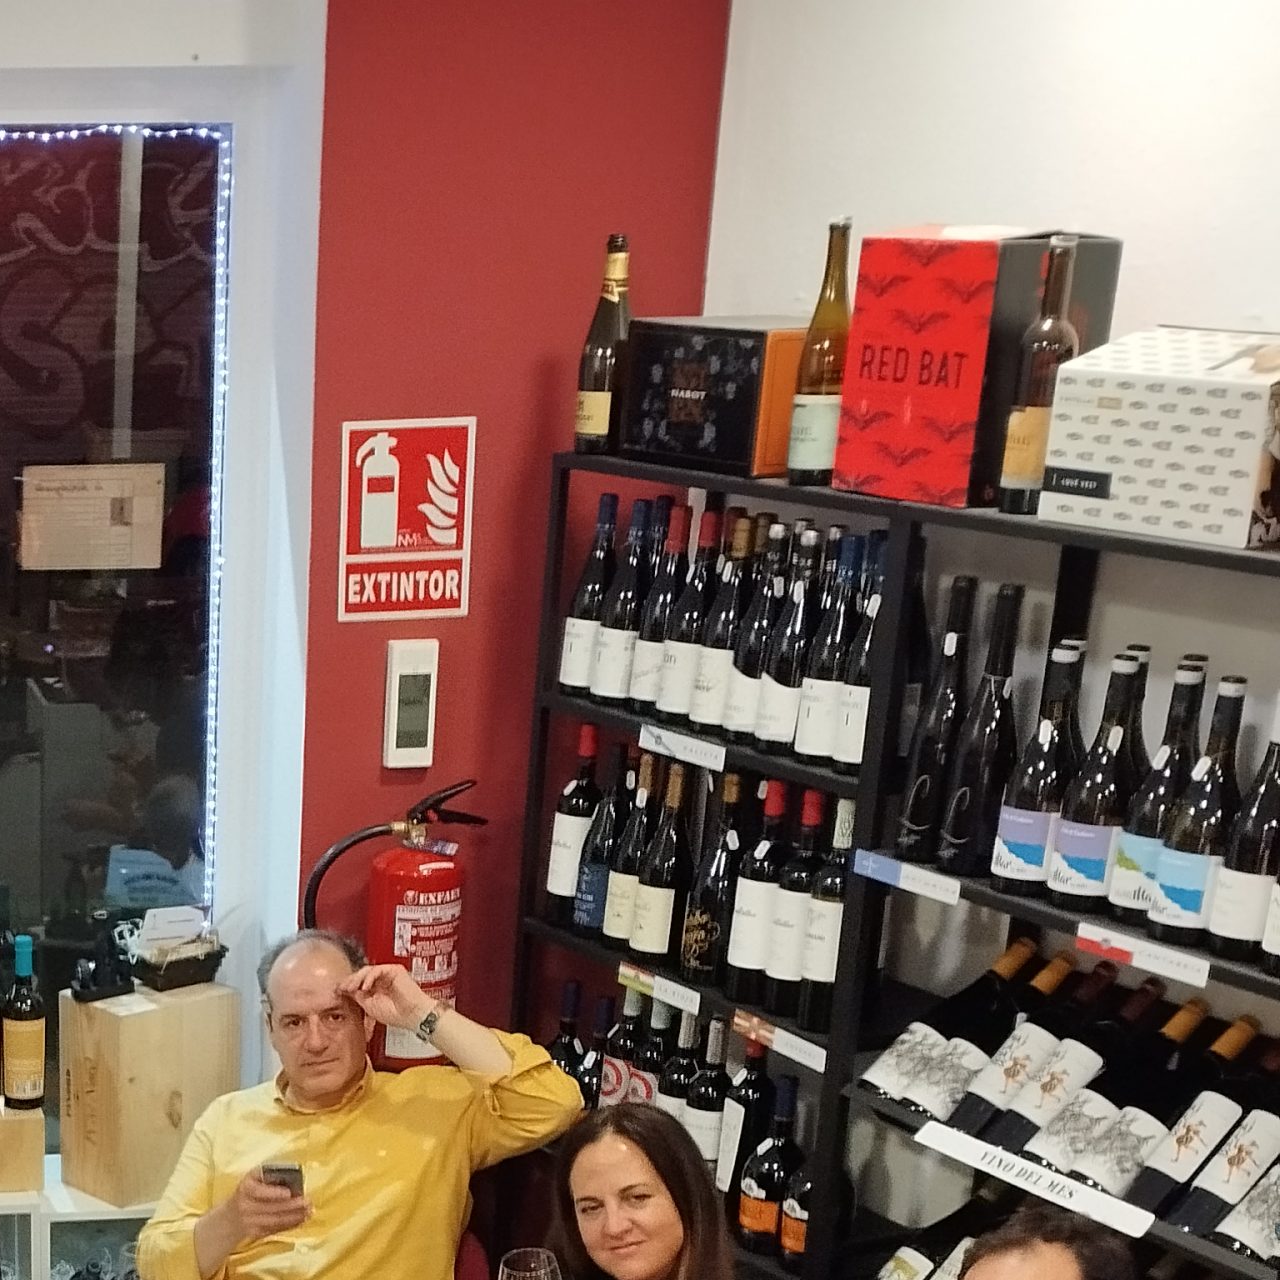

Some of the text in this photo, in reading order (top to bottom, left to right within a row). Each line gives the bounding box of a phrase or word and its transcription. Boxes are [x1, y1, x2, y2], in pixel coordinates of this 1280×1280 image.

[859, 344, 969, 389] RED BAT
[348, 569, 460, 604] EXTINTOR
[980, 1151, 1074, 1199] VINO DEL MES
